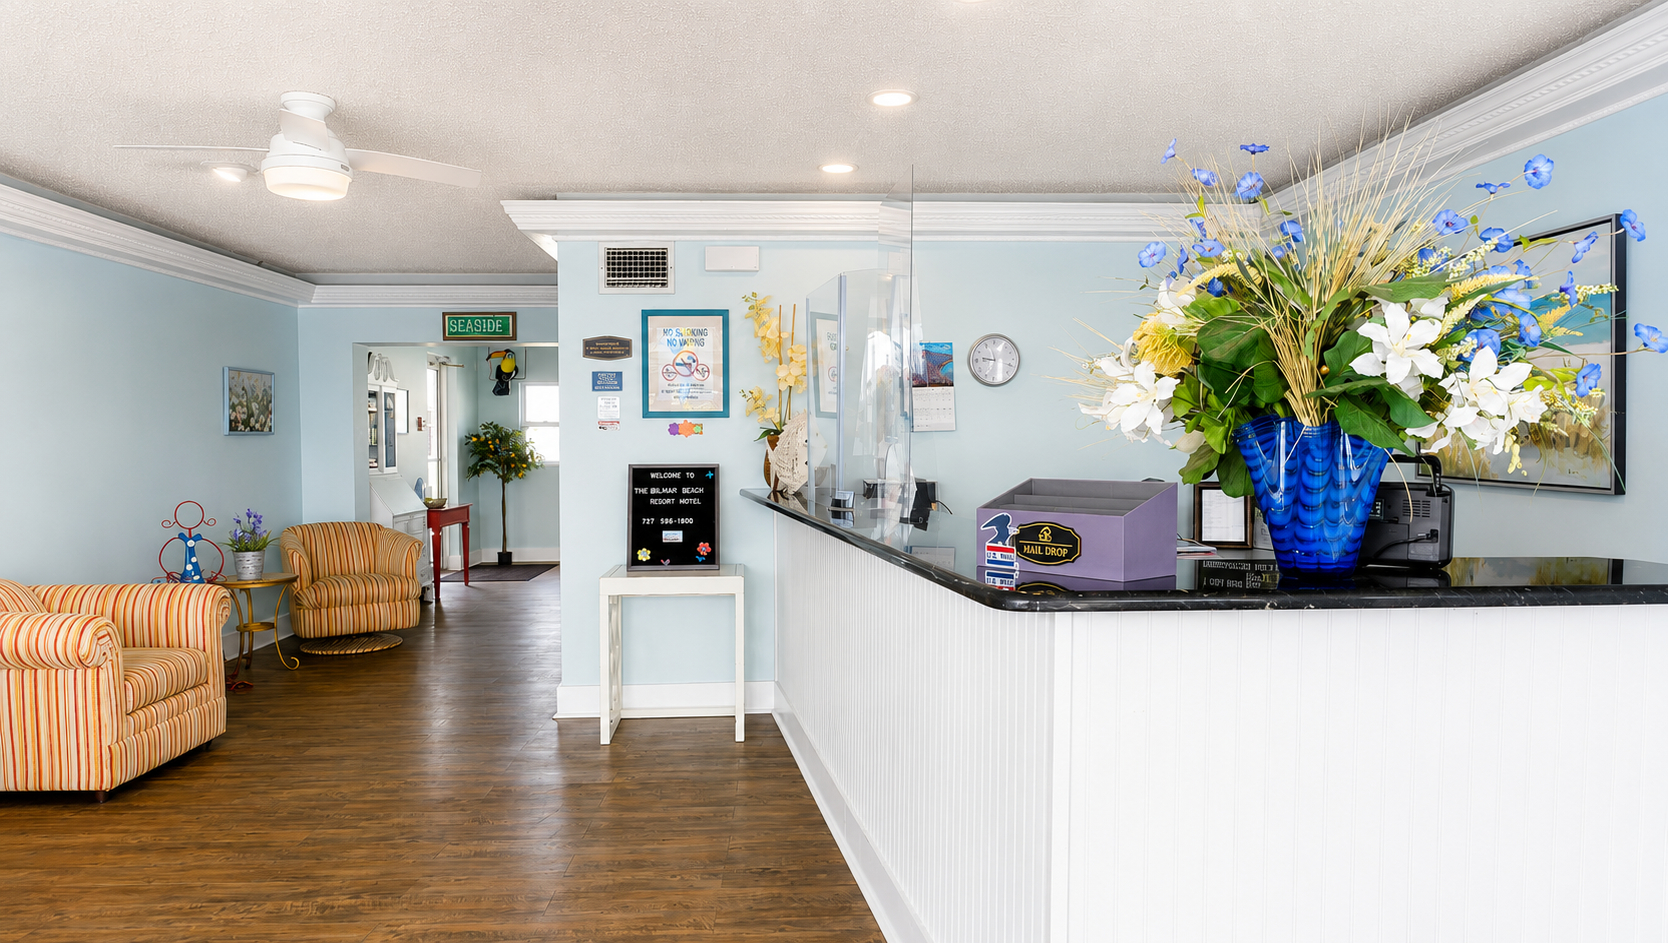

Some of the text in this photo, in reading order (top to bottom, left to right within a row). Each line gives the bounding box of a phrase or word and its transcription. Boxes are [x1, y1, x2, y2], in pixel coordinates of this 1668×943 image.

[450, 319, 503, 332] SEASIDE
[666, 338, 678, 347] NO
[1023, 545, 1068, 558] MAIL DROP
